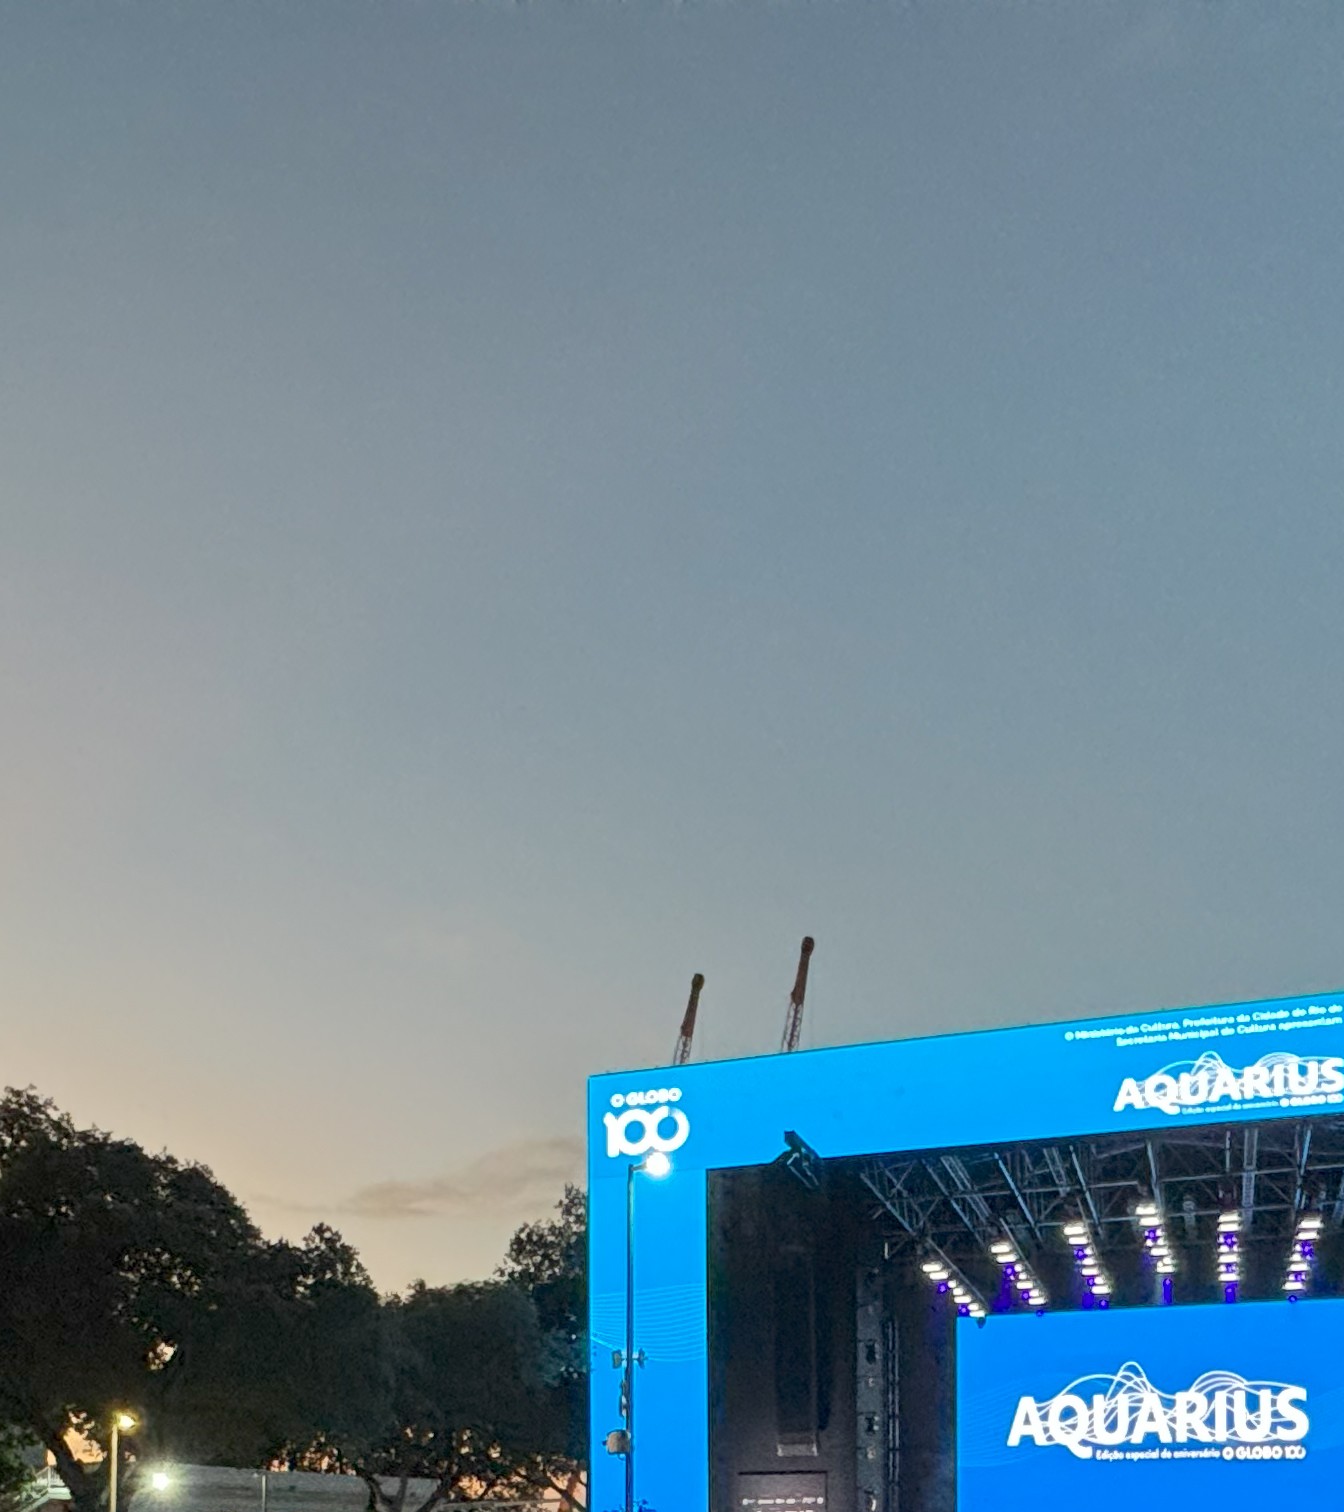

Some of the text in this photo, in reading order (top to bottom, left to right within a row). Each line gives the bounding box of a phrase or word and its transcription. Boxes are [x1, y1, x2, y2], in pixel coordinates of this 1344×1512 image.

[625, 1087, 683, 1106] GLOBO
[603, 1105, 691, 1158] 100
[1006, 1387, 1310, 1460] AQUARIUS
[1221, 1446, 1235, 1460] O
[1235, 1446, 1283, 1460] GLOBO
